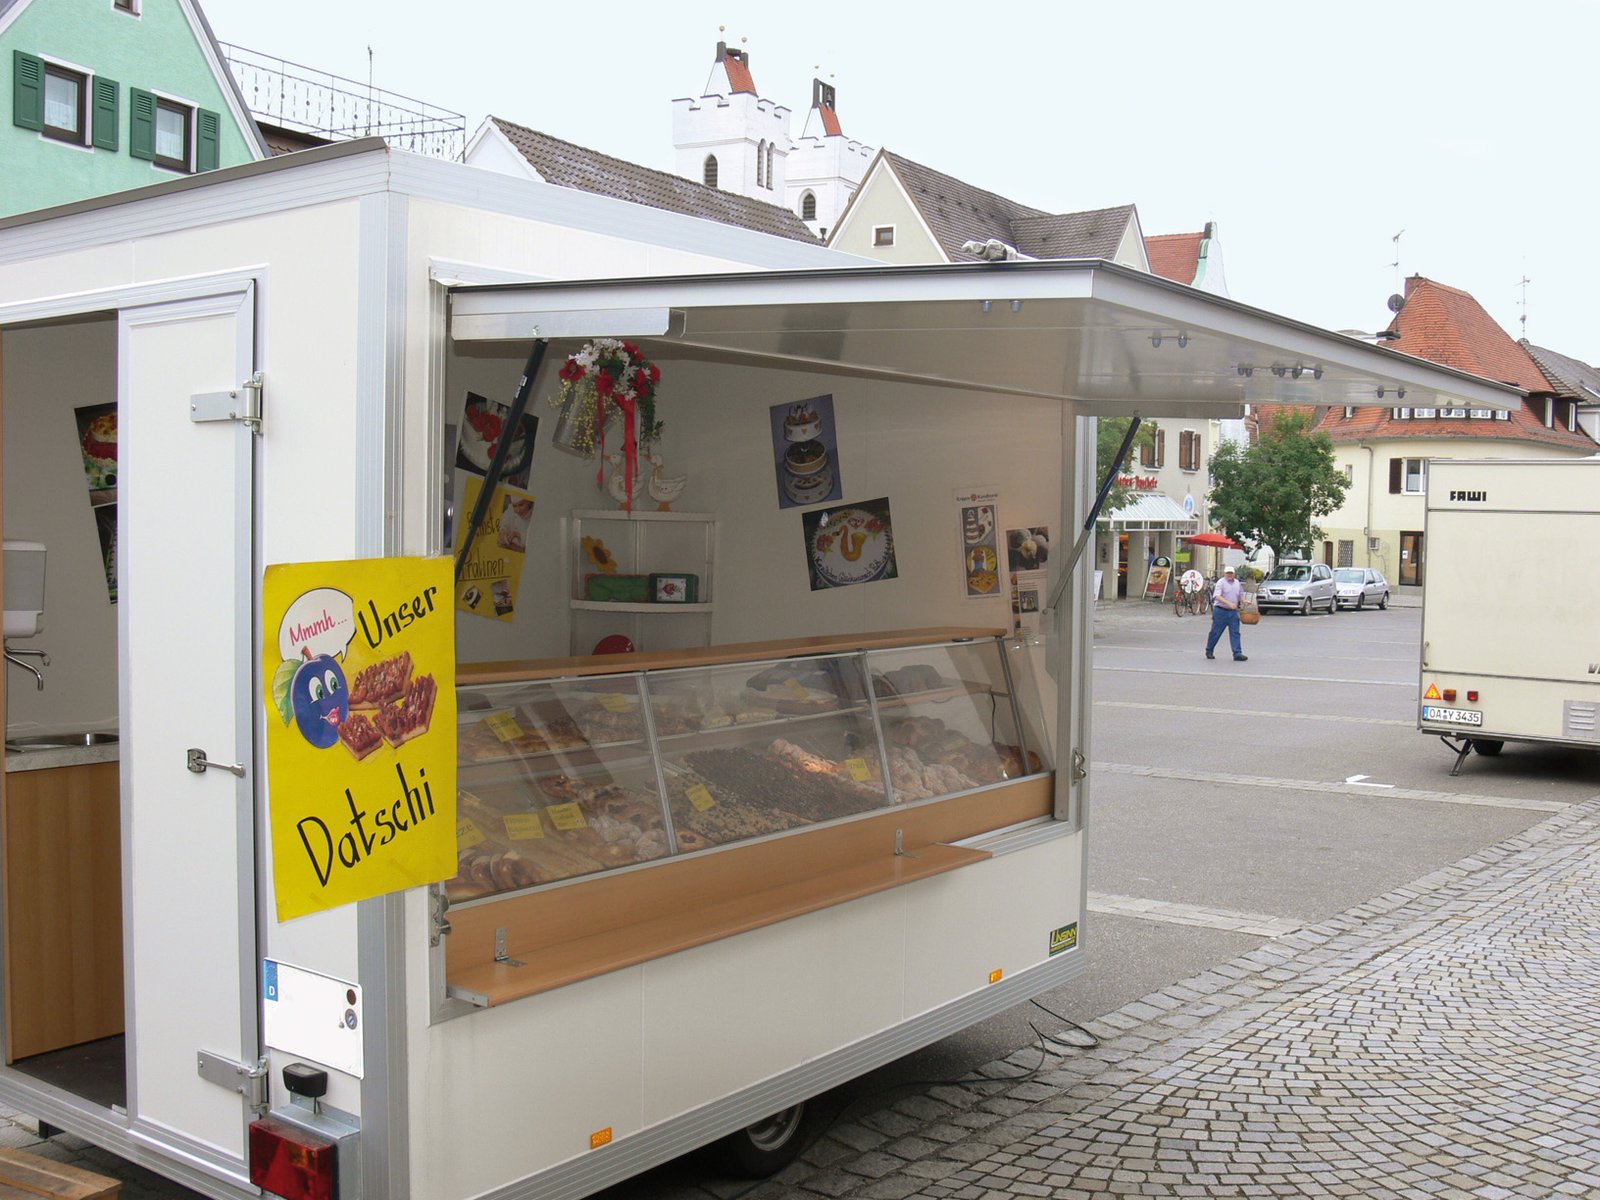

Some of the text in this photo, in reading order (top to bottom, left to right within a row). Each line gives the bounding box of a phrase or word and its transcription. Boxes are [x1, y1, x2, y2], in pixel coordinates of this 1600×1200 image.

[1450, 490, 1487, 502] FAWI
[358, 586, 437, 650] Unser
[1455, 711, 1480, 723] 3435
[296, 763, 435, 888] Datschi
[269, 985, 275, 996] D
